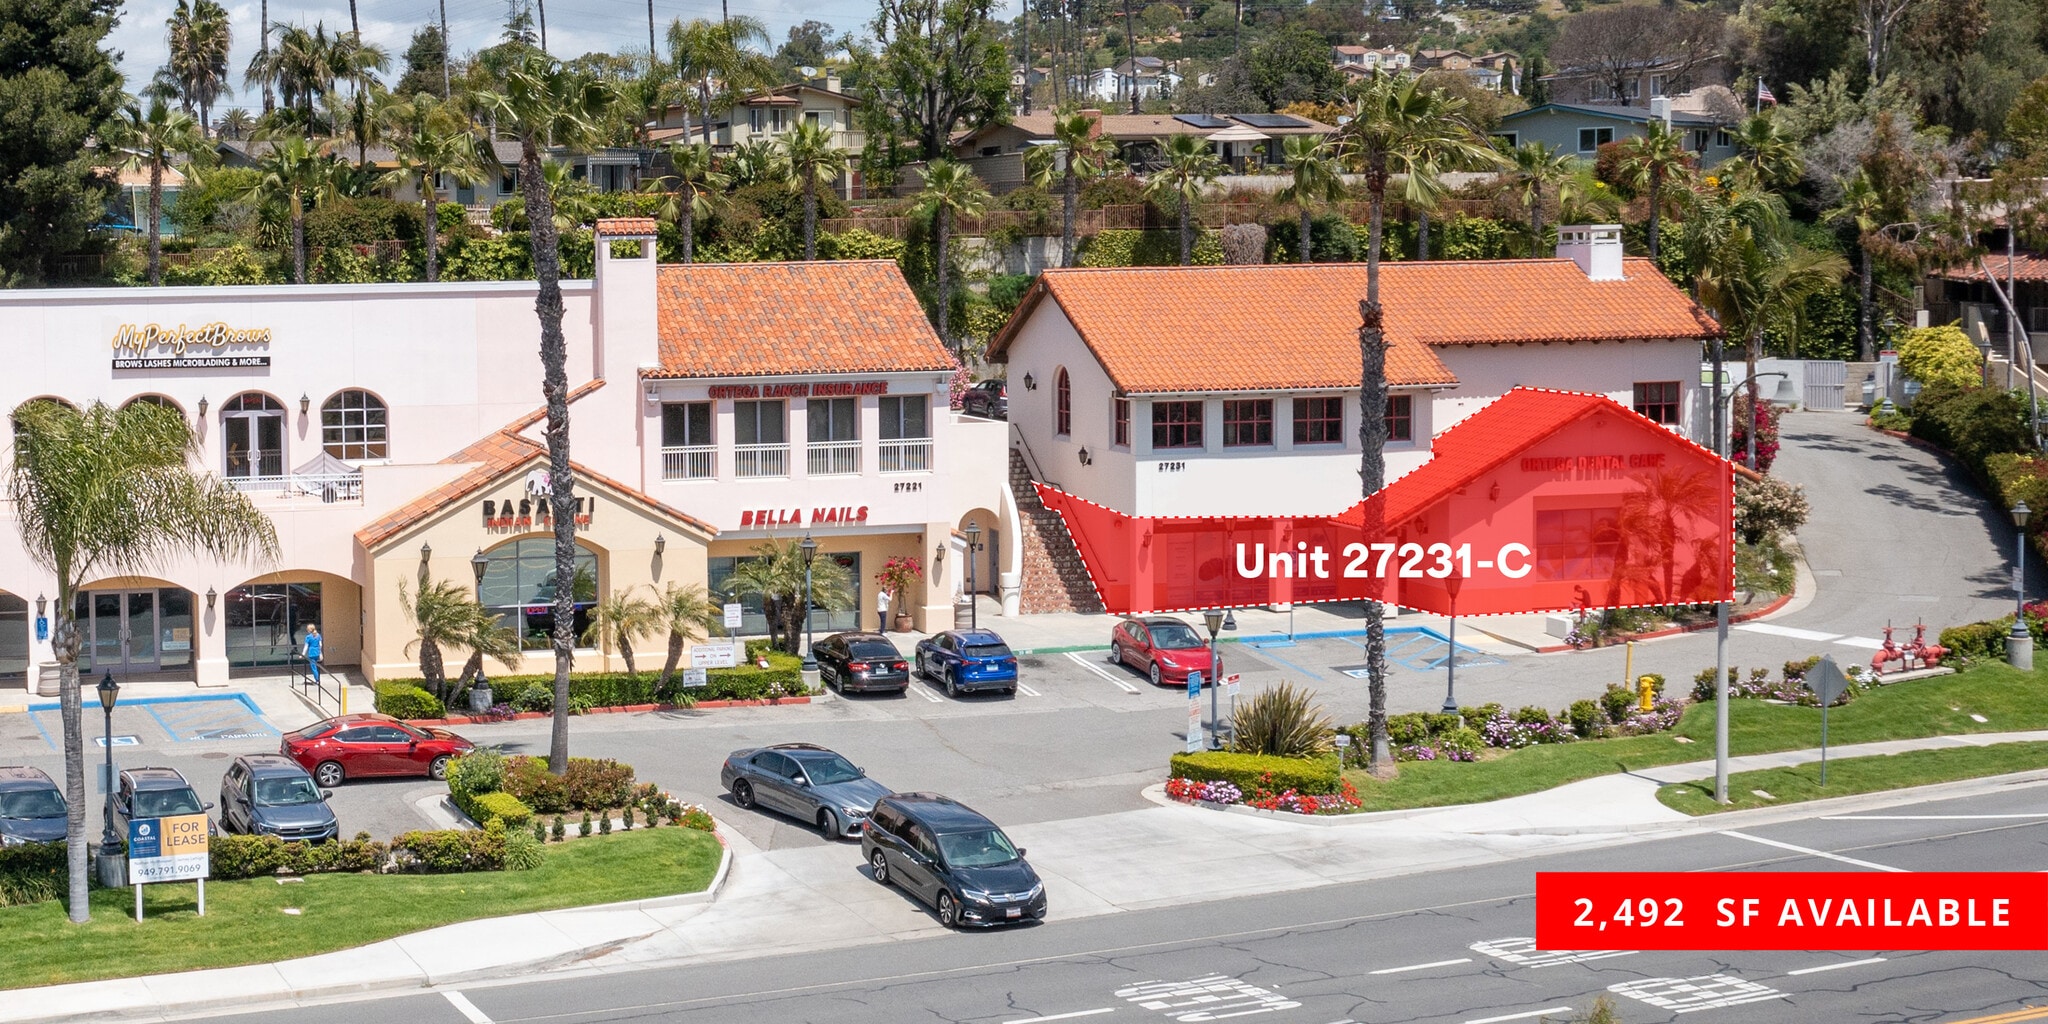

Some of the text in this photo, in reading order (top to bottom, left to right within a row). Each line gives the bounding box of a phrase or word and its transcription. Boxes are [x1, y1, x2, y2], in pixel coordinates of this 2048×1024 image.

[112, 321, 271, 355] MyPerfectBrows
[115, 360, 142, 369] BROWS
[143, 359, 171, 368] LASHES
[172, 359, 230, 368] MICROBLADING
[231, 359, 237, 367] &
[708, 381, 888, 399] ORTEGA RANCH INSURANCE
[1158, 462, 1186, 471] 27231
[1520, 453, 1666, 473] ORTEGA DENTAL CARE
[893, 482, 923, 492] 27221
[483, 496, 595, 516] BASATI
[487, 516, 532, 528] INDIAN
[740, 505, 869, 526] BELLA NAILS
[173, 822, 199, 833] FOR
[166, 834, 206, 847] LEASE
[138, 864, 201, 877] 949.791.9069
[1606, 973, 1794, 1013] KEEP
